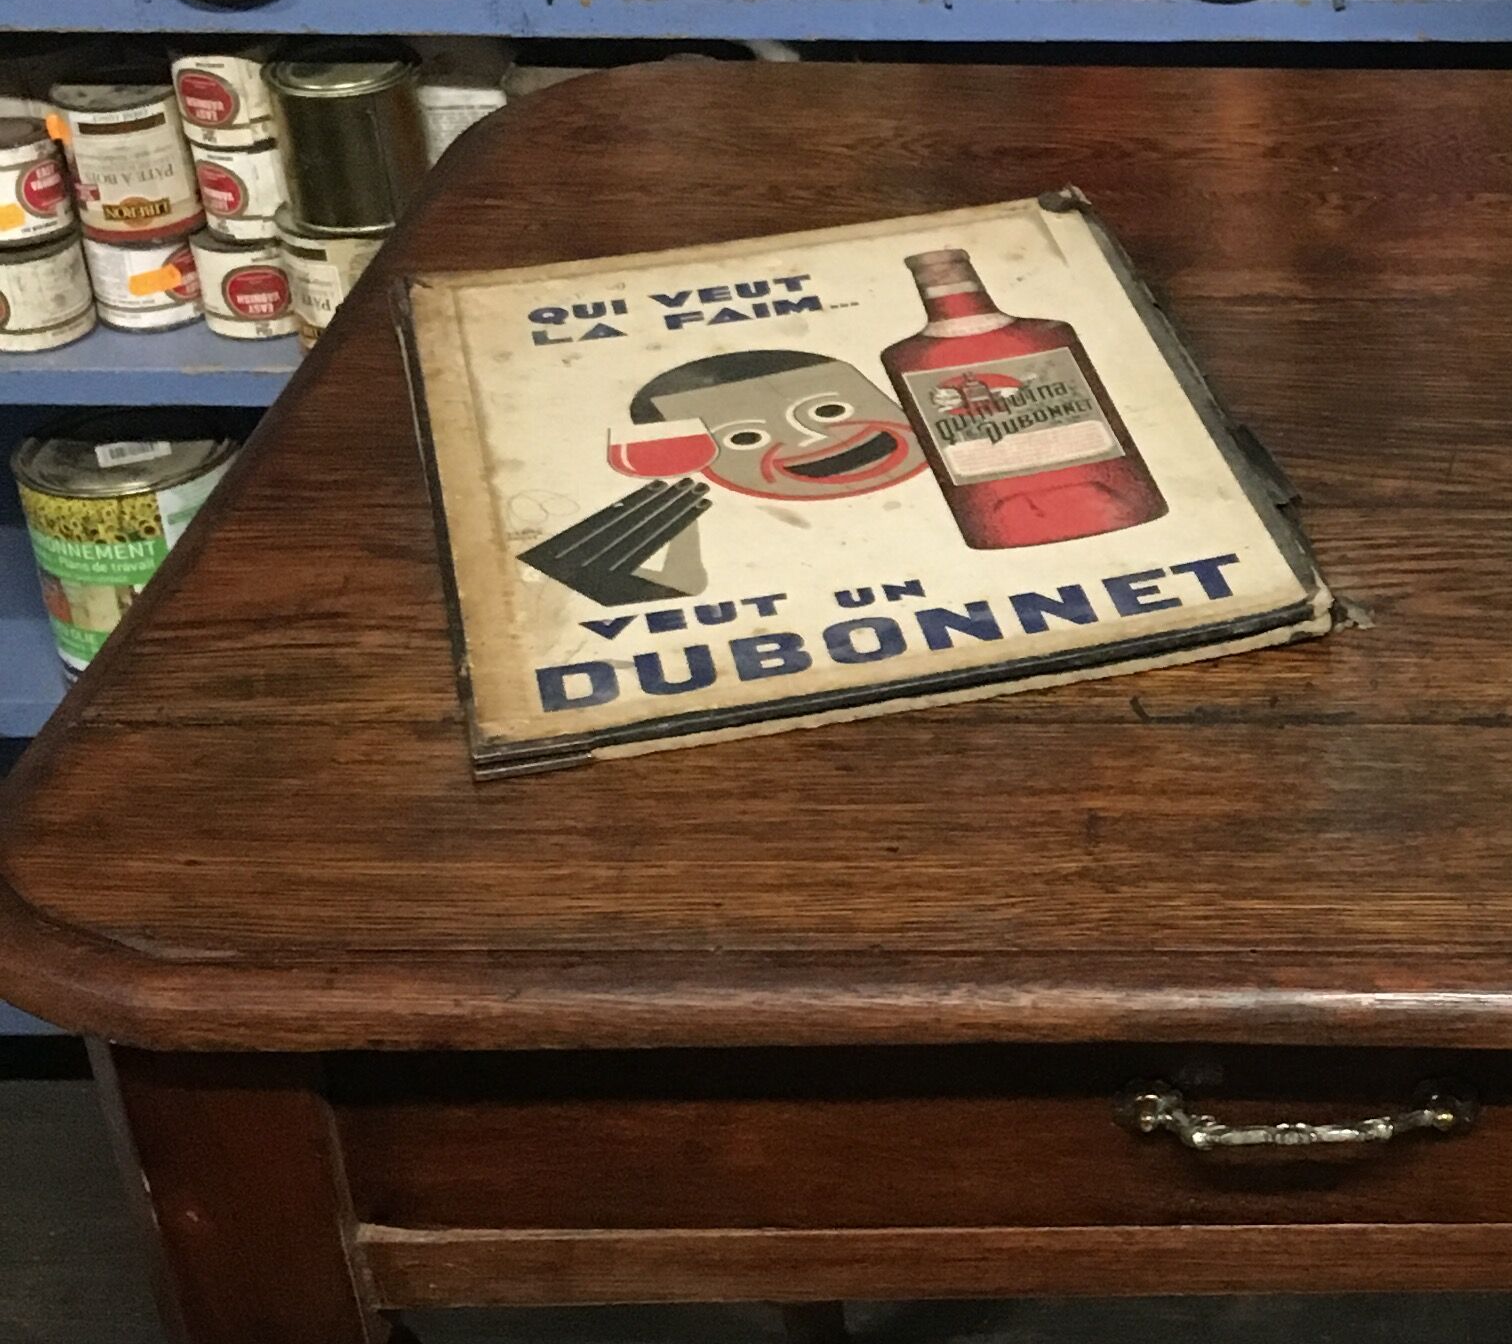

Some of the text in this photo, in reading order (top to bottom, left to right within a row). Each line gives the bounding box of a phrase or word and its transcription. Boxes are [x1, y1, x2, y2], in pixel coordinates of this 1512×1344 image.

[104, 200, 170, 222] LIBERON
[527, 274, 811, 326] QUI VEUT
[531, 322, 629, 346] LA
[978, 398, 1094, 445] DUBONNET
[91, 559, 109, 573] de
[110, 558, 155, 573] travail
[534, 553, 1241, 713] DUBONNET
[579, 579, 926, 640] VEUT UN
